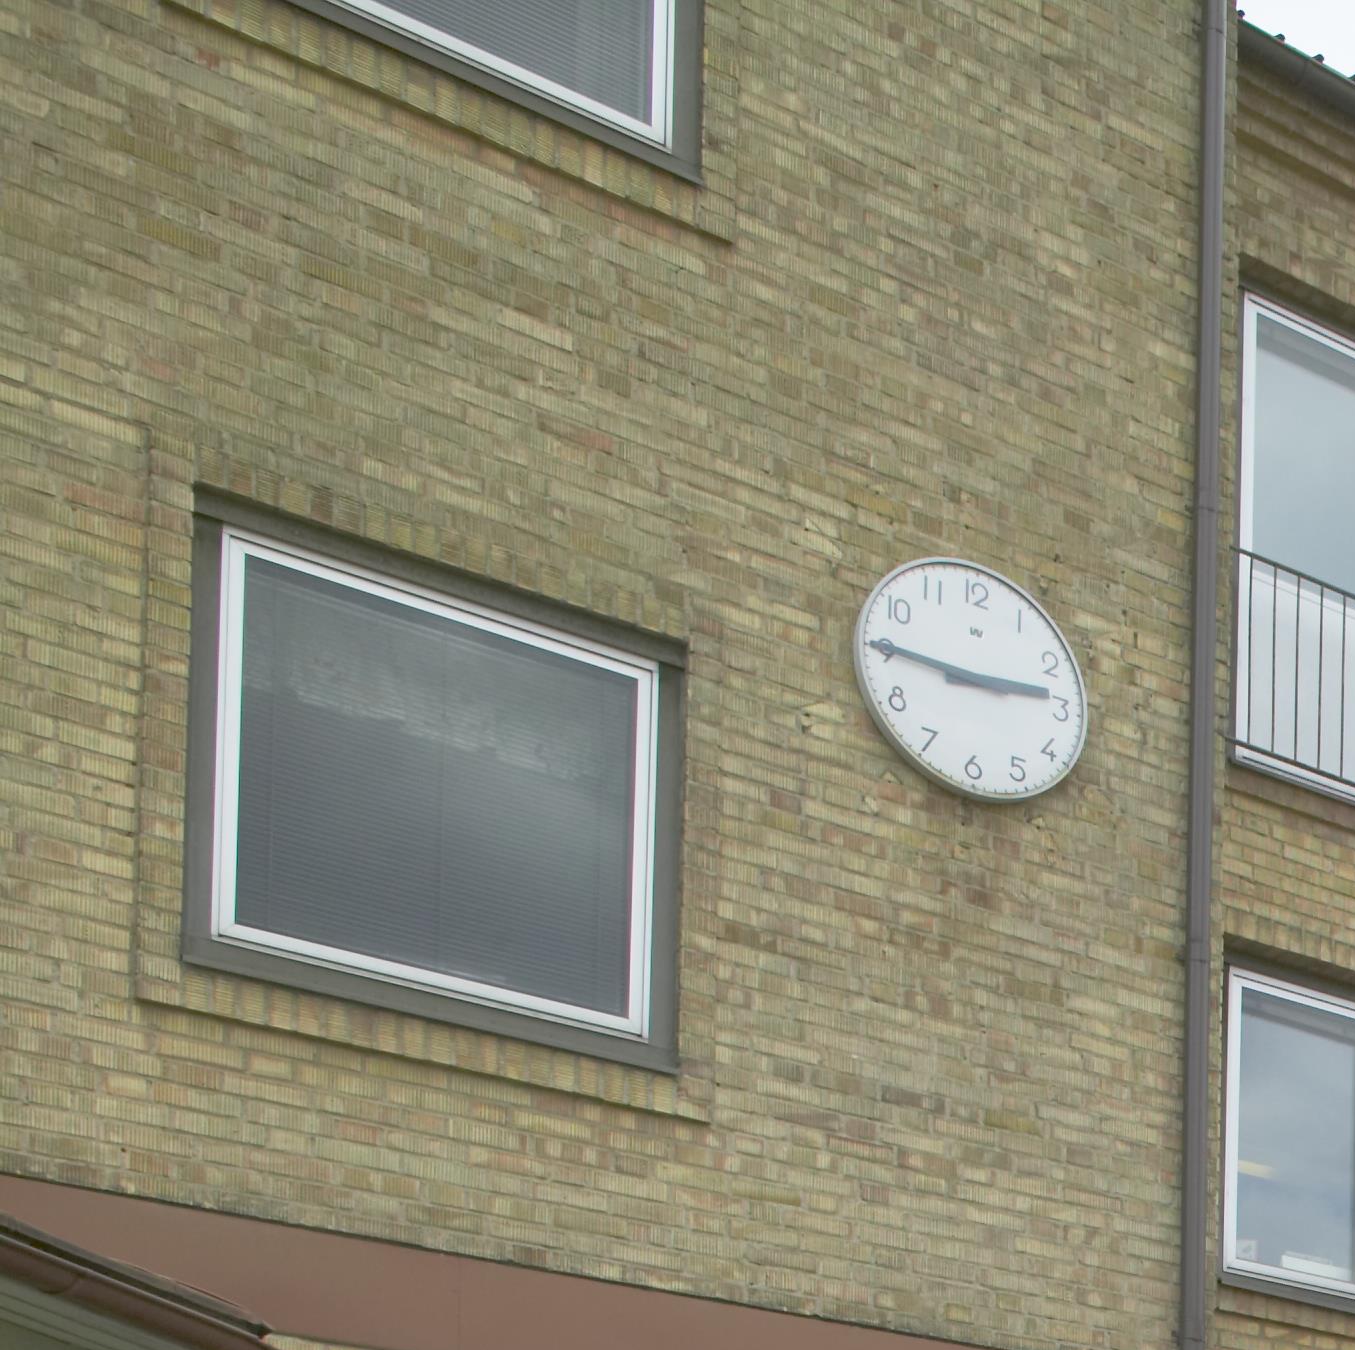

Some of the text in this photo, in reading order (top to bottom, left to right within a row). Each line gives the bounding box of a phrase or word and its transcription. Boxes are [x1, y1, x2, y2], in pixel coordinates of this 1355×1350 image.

[923, 575, 942, 605] 11
[965, 578, 989, 610] 12
[887, 594, 911, 624] 10
[1016, 609, 1023, 633] 1
[878, 638, 896, 663] 9
[1041, 651, 1059, 677] 2
[888, 686, 907, 712] 8
[1052, 695, 1069, 722] 3
[921, 726, 938, 752] 7
[1040, 738, 1057, 762] 4
[964, 755, 983, 780] 6
[1009, 756, 1027, 782] 5
